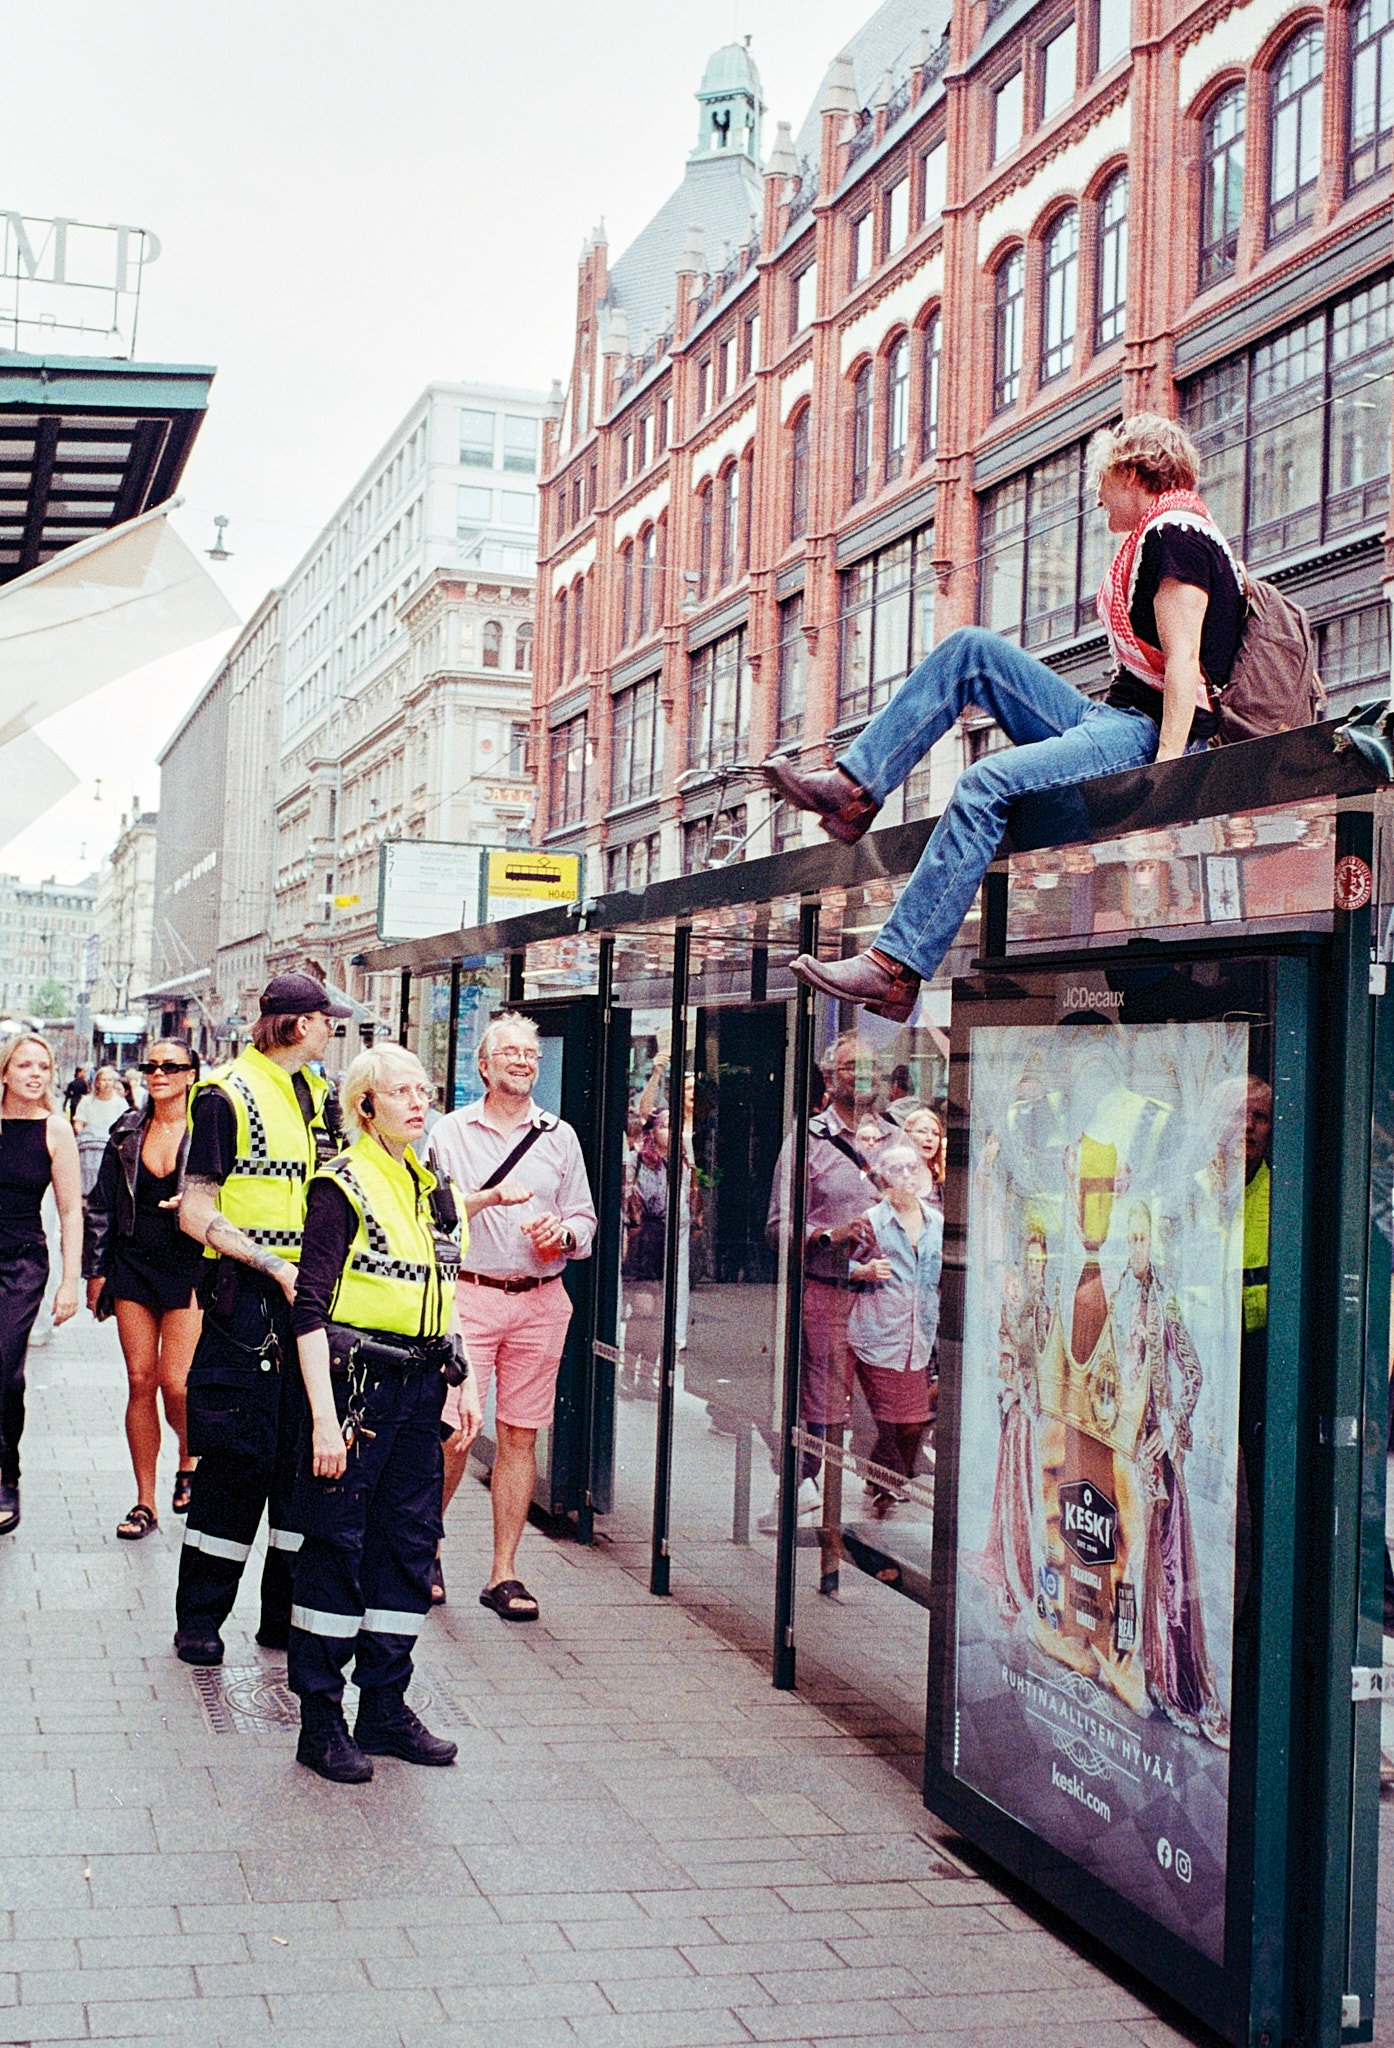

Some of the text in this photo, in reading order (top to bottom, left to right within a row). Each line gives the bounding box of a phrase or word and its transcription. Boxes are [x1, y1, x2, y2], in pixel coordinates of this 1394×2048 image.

[388, 846, 395, 858] 5
[388, 861, 395, 872] 7
[1062, 986, 1125, 1009] JCDecaux
[1065, 1501, 1111, 1549] KESKI
[1001, 1665, 1174, 1788] RUHTINAALLISEN HYVÄÄ
[1052, 1761, 1111, 1823] keski.com
